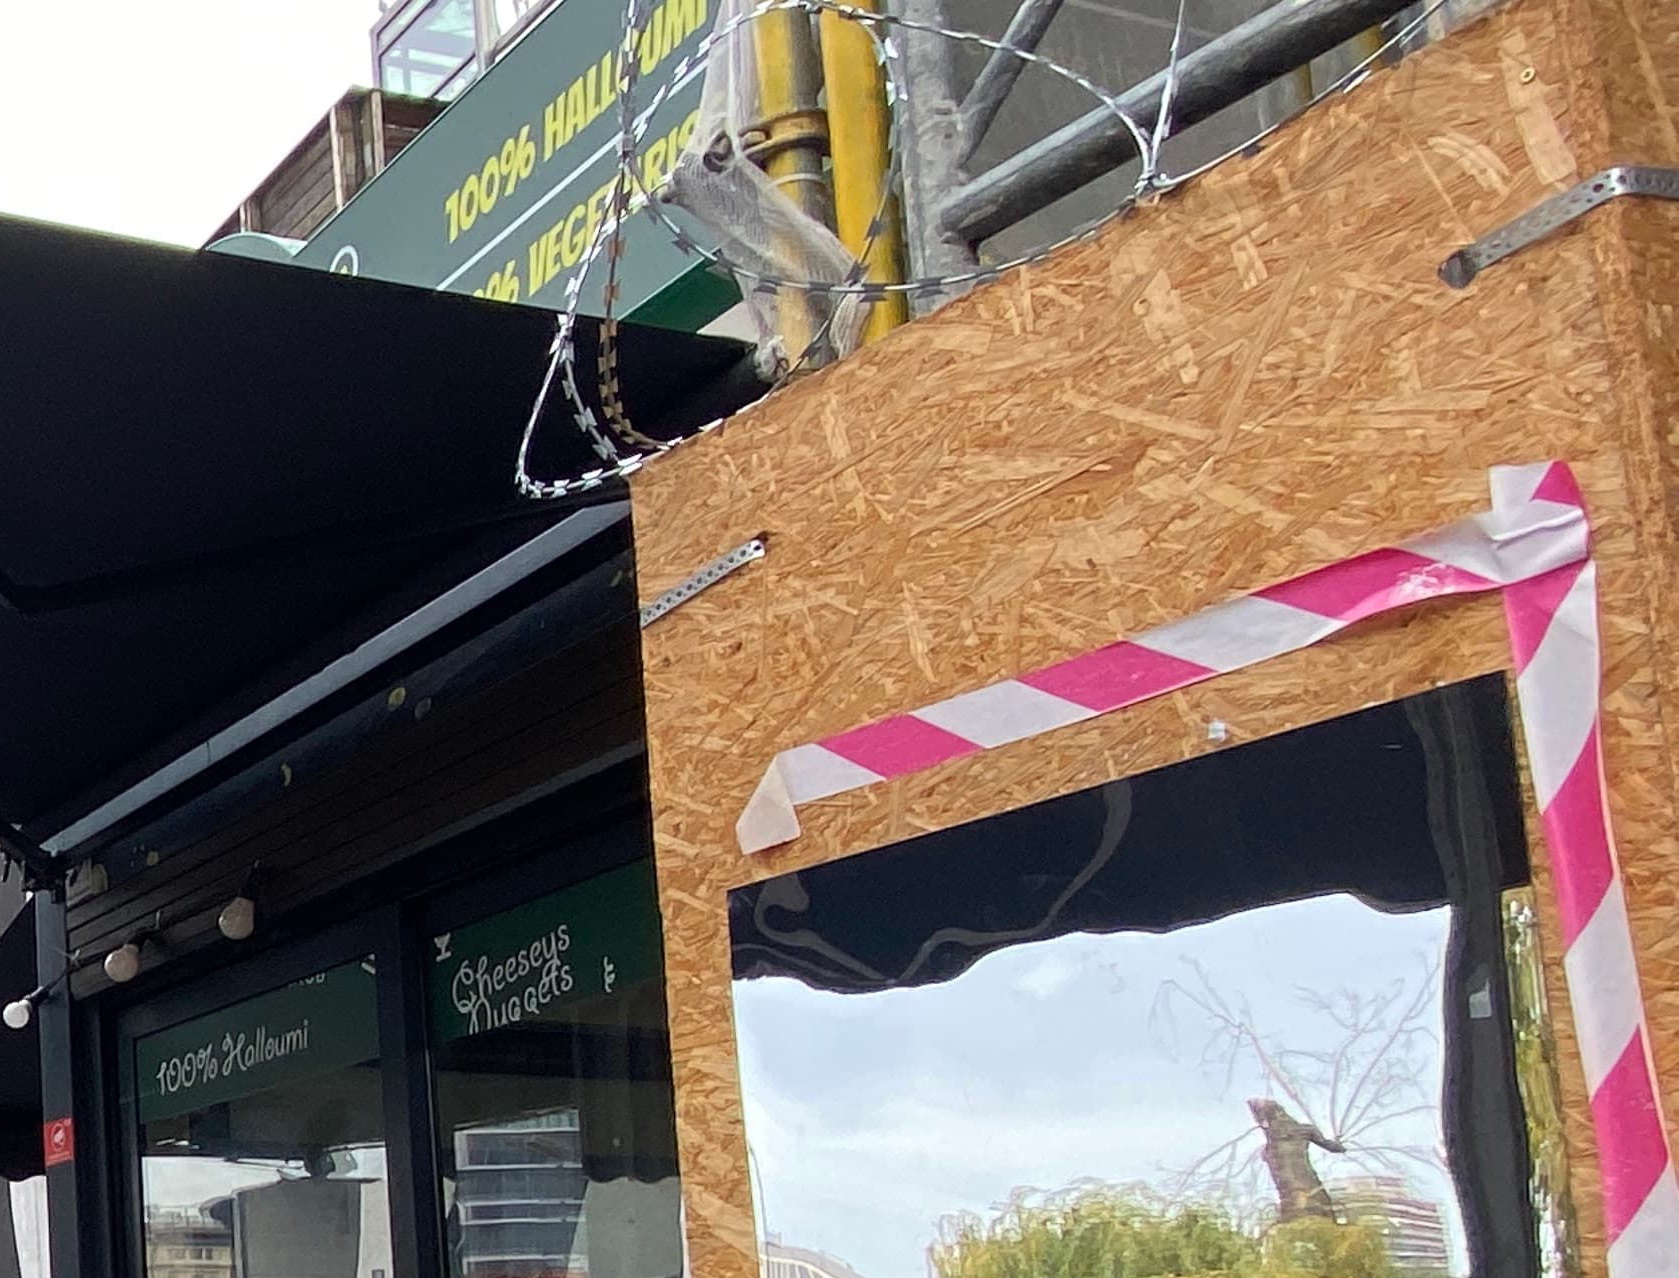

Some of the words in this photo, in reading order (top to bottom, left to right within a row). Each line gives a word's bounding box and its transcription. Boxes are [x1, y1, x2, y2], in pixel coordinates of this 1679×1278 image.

[445, 124, 536, 244] 100%
[452, 924, 571, 1014] Cheeseys
[156, 1043, 218, 1096] 100%
[222, 1018, 309, 1076] Halloumi
